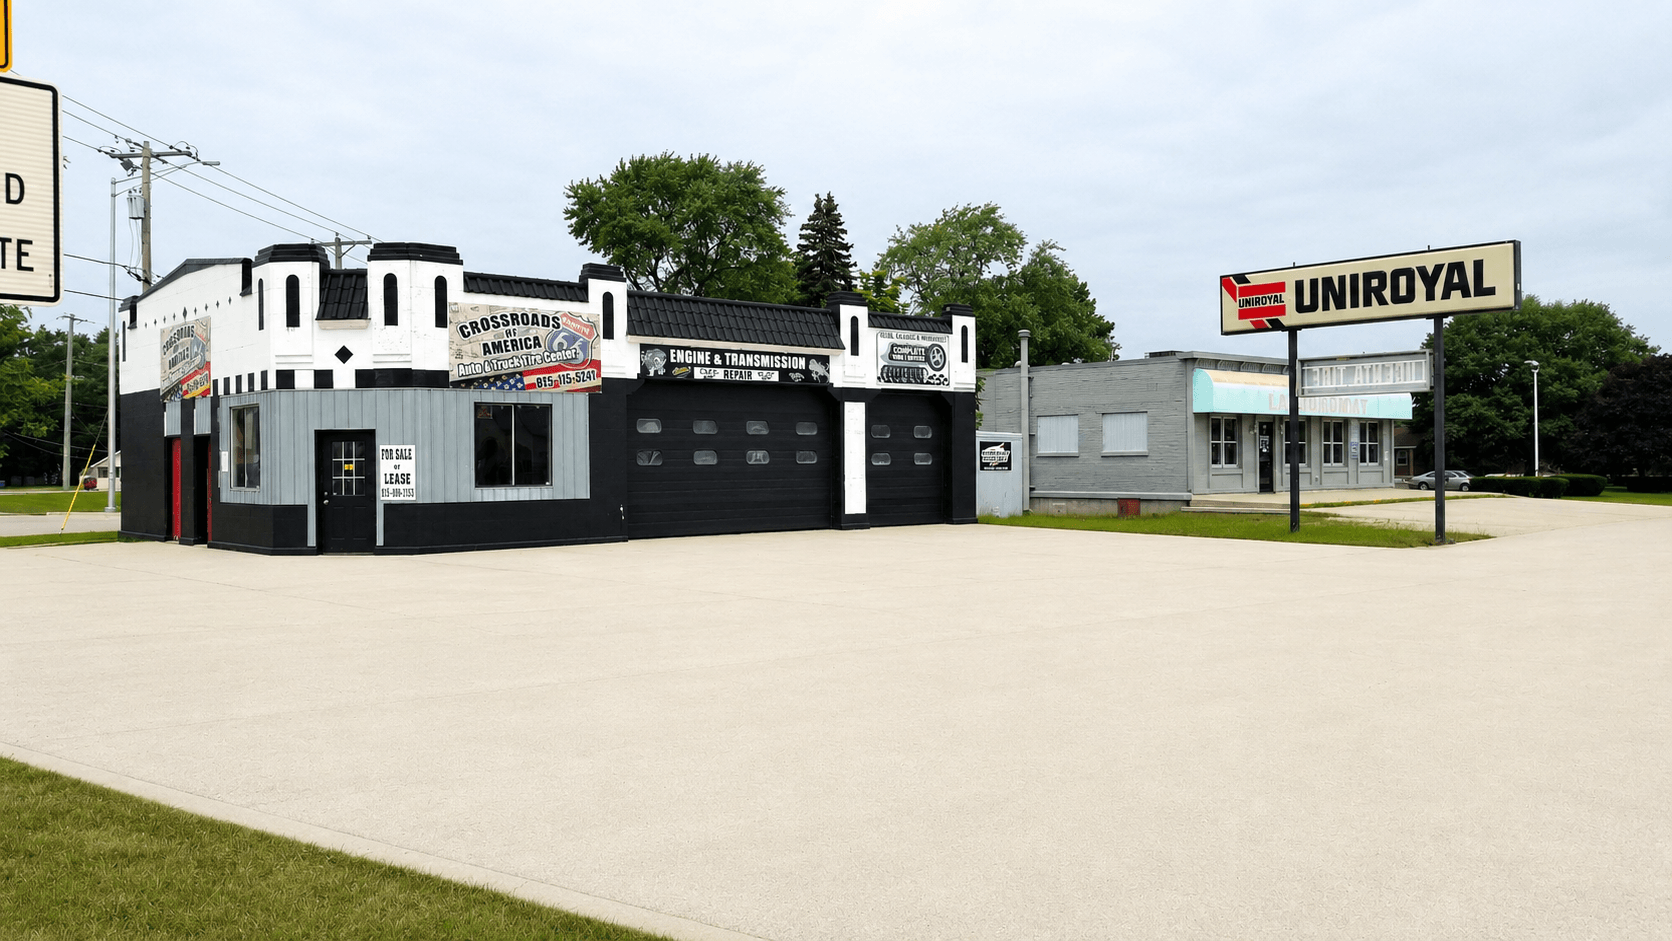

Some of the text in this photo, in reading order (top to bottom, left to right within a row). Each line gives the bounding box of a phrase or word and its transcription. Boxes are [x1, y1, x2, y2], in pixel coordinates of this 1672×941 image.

[0, 236, 34, 272] TE
[1295, 259, 1496, 314] UNIROYAL
[1238, 293, 1285, 309] UNIROYAL
[458, 312, 561, 339] CROSSROADS
[482, 335, 542, 356] AMERICA
[457, 362, 482, 377] Auto
[491, 356, 521, 371] Truck
[670, 348, 806, 369] ENGINE & TRANSMISSION
[723, 369, 753, 380] REPAIR
[381, 448, 412, 460] FOR SALE
[384, 472, 411, 485] LEASE
